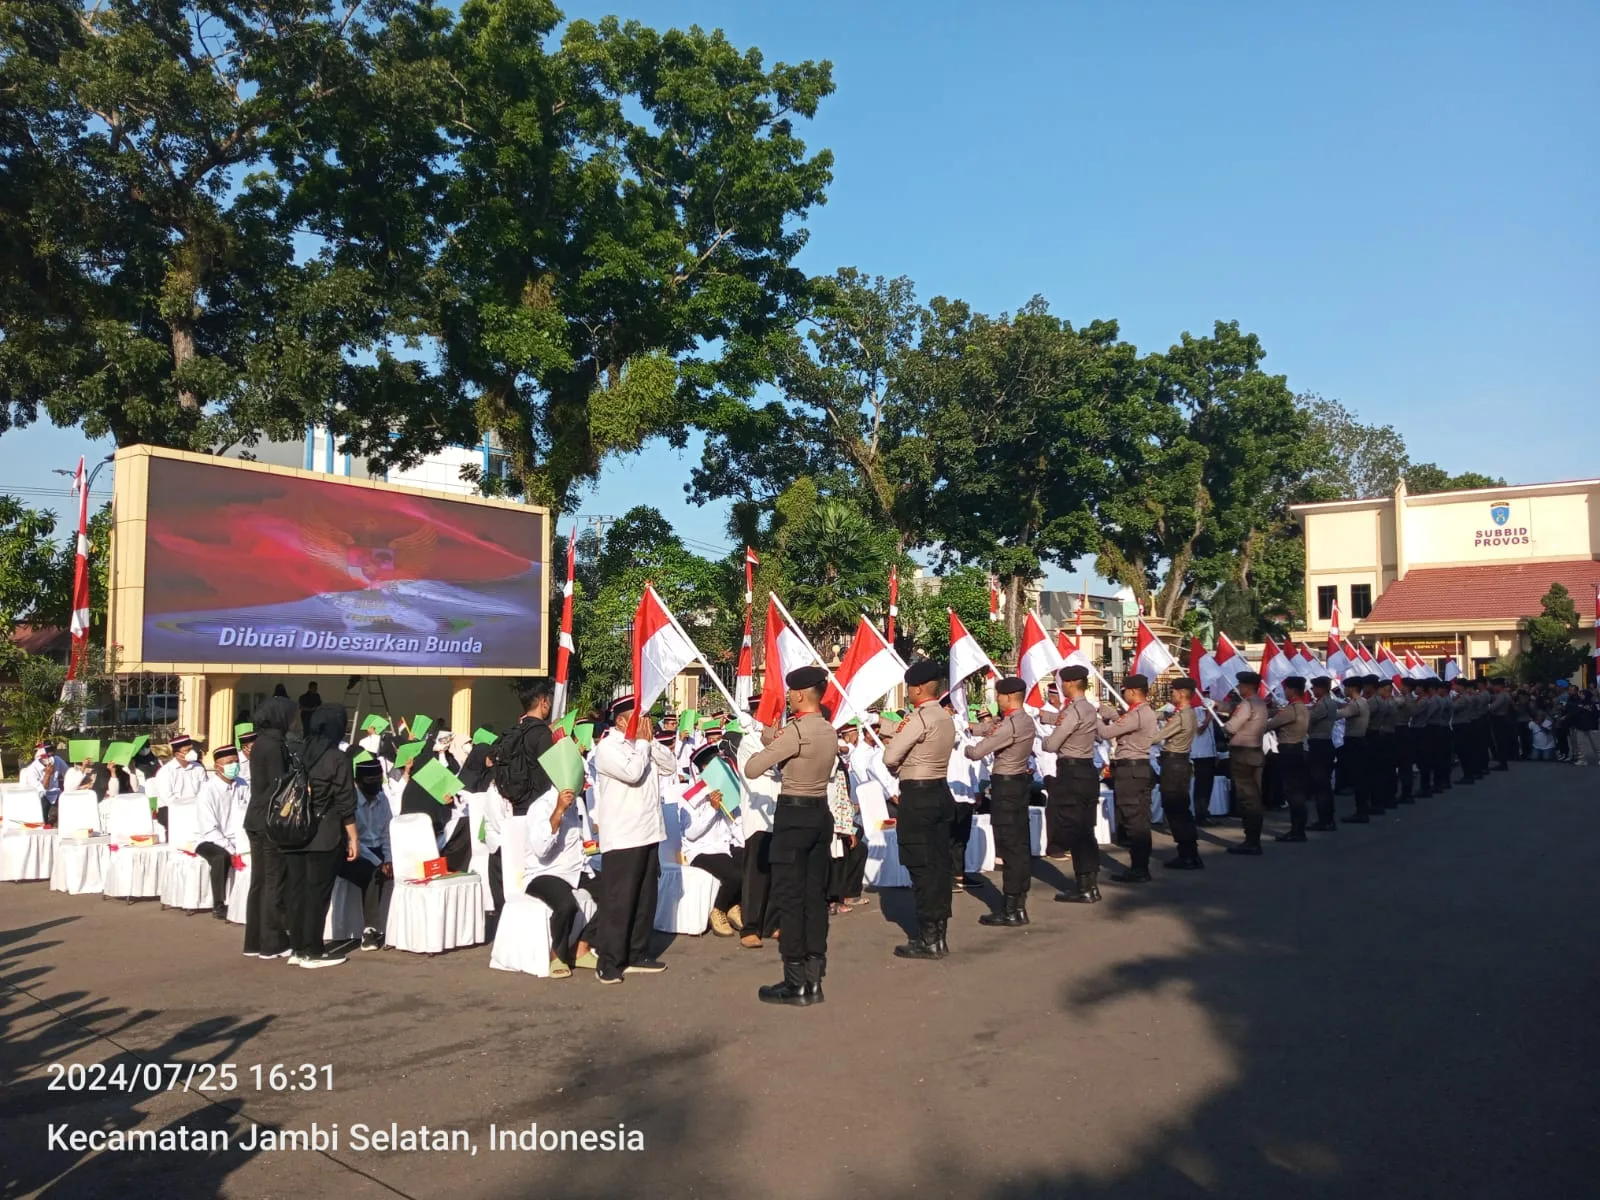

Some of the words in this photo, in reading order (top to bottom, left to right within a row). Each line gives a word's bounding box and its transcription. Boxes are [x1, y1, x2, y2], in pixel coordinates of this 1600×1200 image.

[1475, 527, 1527, 538] SUBBID
[1474, 536, 1529, 547] PROVOS
[218, 627, 298, 648] Dibuai
[301, 631, 420, 652] Dibesarkan
[424, 635, 483, 653] Bunda
